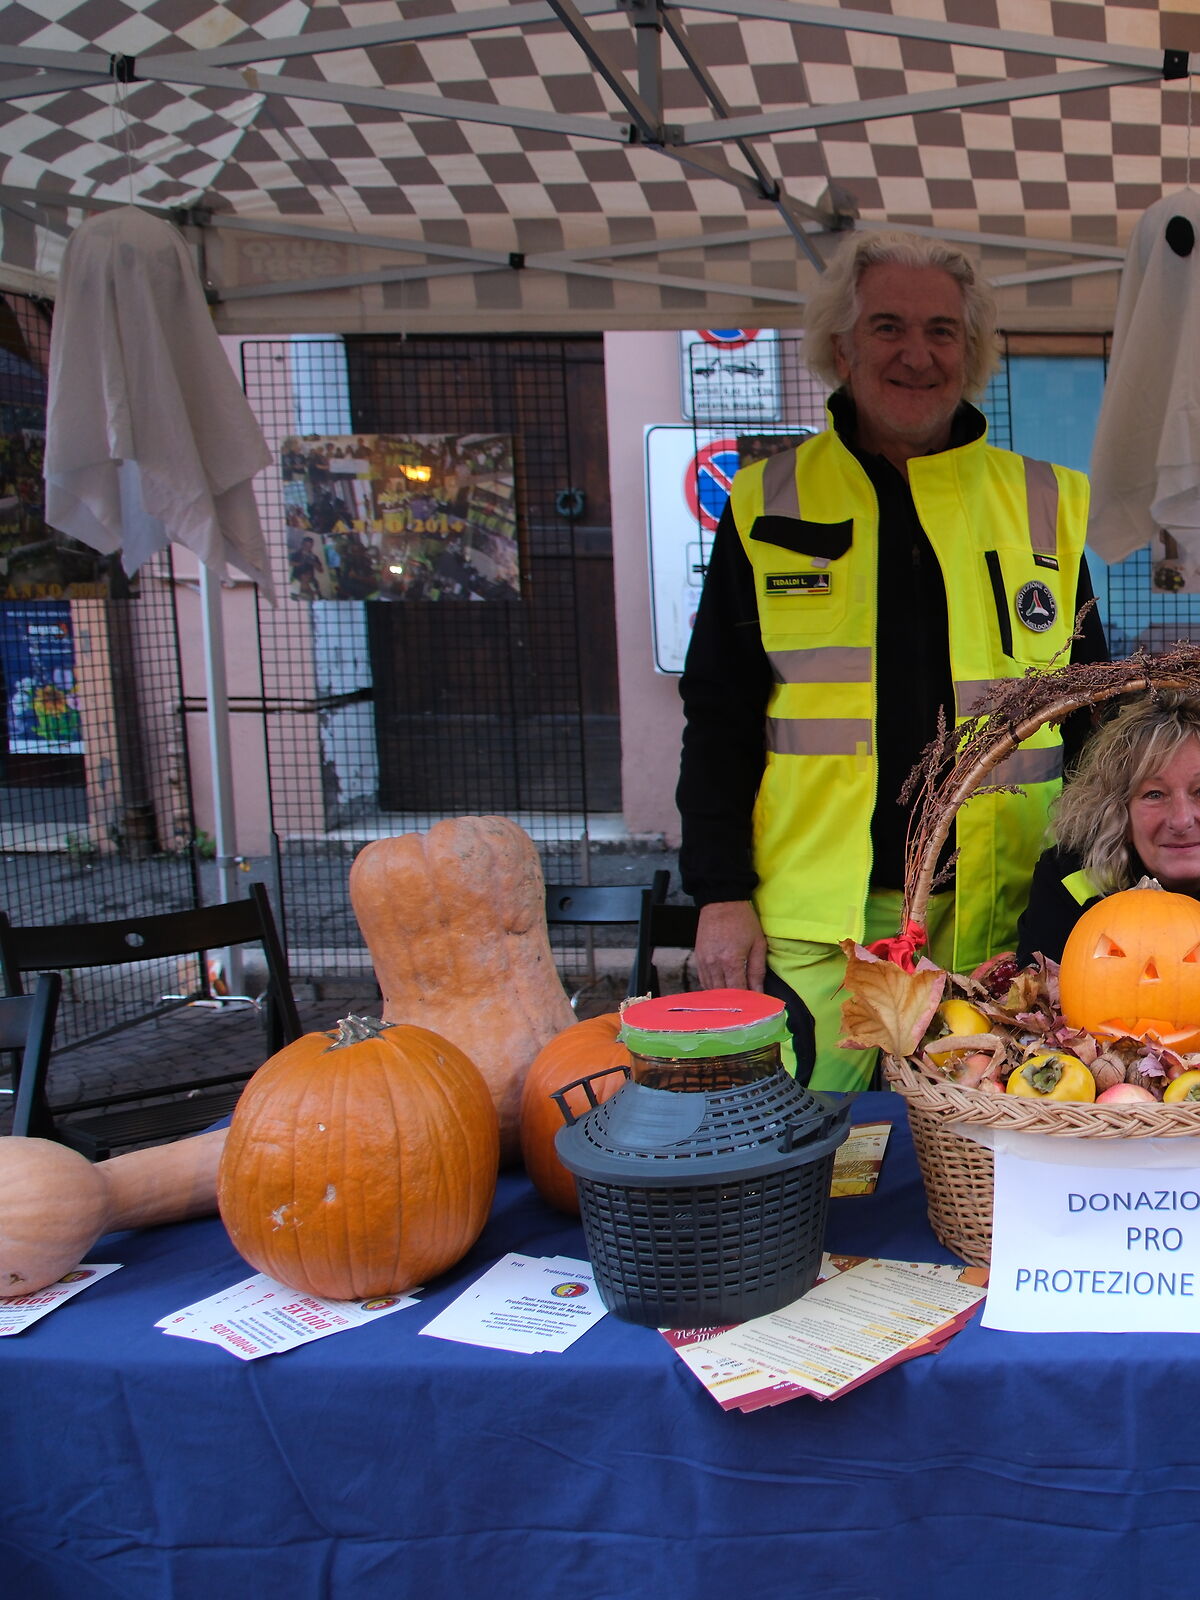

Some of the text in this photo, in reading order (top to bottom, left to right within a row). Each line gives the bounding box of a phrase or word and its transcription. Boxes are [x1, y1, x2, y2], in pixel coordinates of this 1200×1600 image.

[331, 519, 466, 533] ANNO 2014
[5, 583, 63, 598] ANNO
[1018, 582, 1054, 608] PROTEZIONE CIVILE
[1026, 620, 1052, 630] MELDOLA
[1126, 1226, 1183, 1250] PRO
[1015, 1268, 1194, 1296] PROTEZIONE
[282, 1303, 332, 1330] 5X1000
[674, 1328, 696, 1340] Nel
